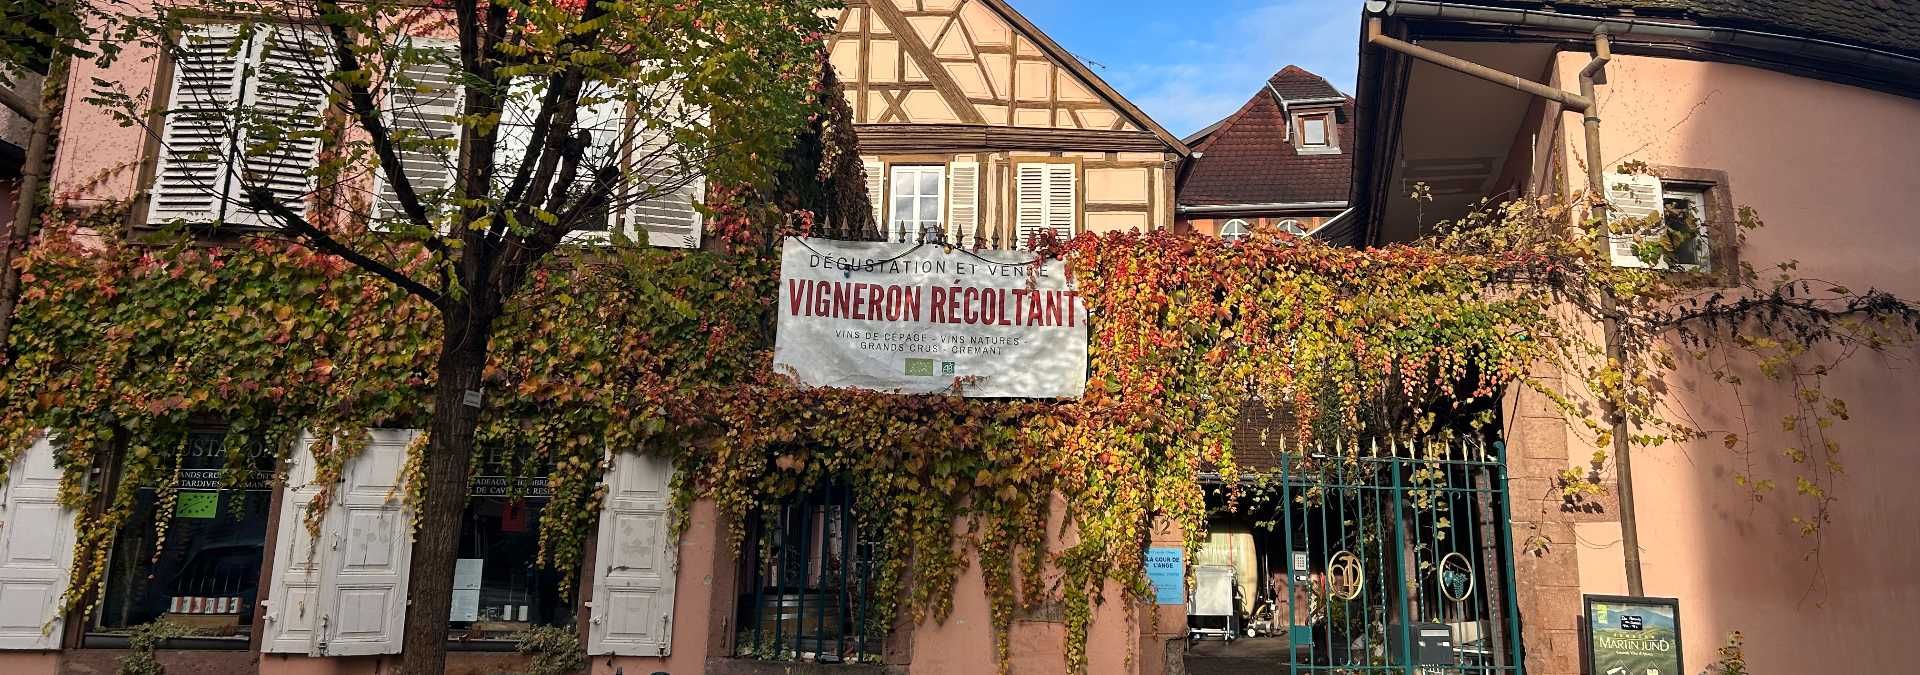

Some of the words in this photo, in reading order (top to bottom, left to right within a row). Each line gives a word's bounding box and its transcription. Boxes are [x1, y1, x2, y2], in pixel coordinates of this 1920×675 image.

[809, 252, 945, 274] DÉGUSTATION
[956, 262, 978, 275] ET
[987, 263, 1049, 278] VENE
[788, 278, 921, 322] VIGNERON
[930, 279, 1080, 328] RÉCOLTANT
[835, 329, 860, 339] VINS
[865, 332, 879, 340] DE
[940, 335, 965, 344] VINS
[970, 336, 1019, 346] NATURES
[860, 341, 904, 352] GRANDS
[909, 343, 938, 353] CRUS
[1599, 637, 1640, 651] MARTIN
[1641, 637, 1670, 652] JUND
